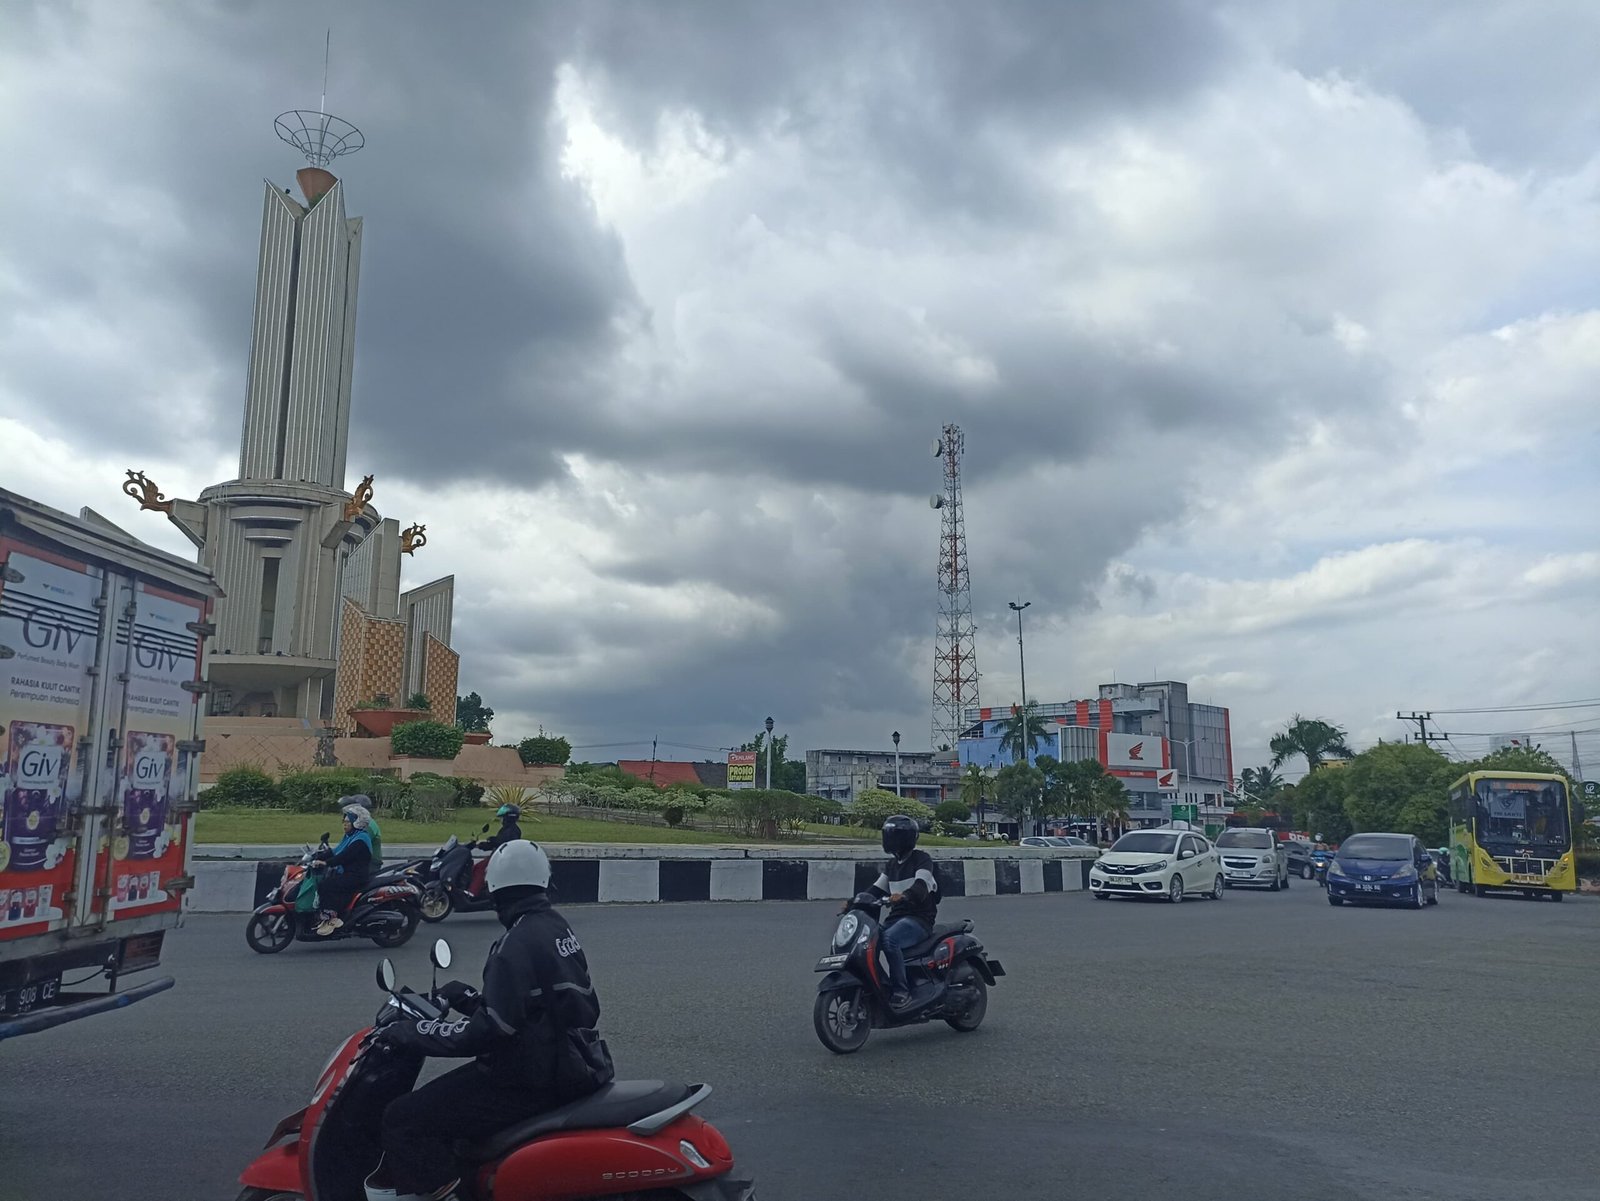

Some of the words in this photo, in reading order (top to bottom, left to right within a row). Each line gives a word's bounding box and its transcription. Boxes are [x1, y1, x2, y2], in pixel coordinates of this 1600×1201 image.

[23, 606, 82, 654] Giv
[136, 633, 180, 672] Giv
[10, 688, 49, 702] Perempuan
[50, 694, 80, 706] Indonesia
[11, 677, 39, 688] RAHASIA
[41, 682, 58, 691] KULIT
[59, 684, 81, 694] CANTIK
[22, 750, 58, 777] Giv
[136, 756, 164, 779] Giv
[730, 765, 753, 775] PROMO
[556, 928, 581, 957] Grab
[20, 986, 37, 1005] 908
[42, 982, 55, 999] CE
[417, 1017, 471, 1037] Grab
